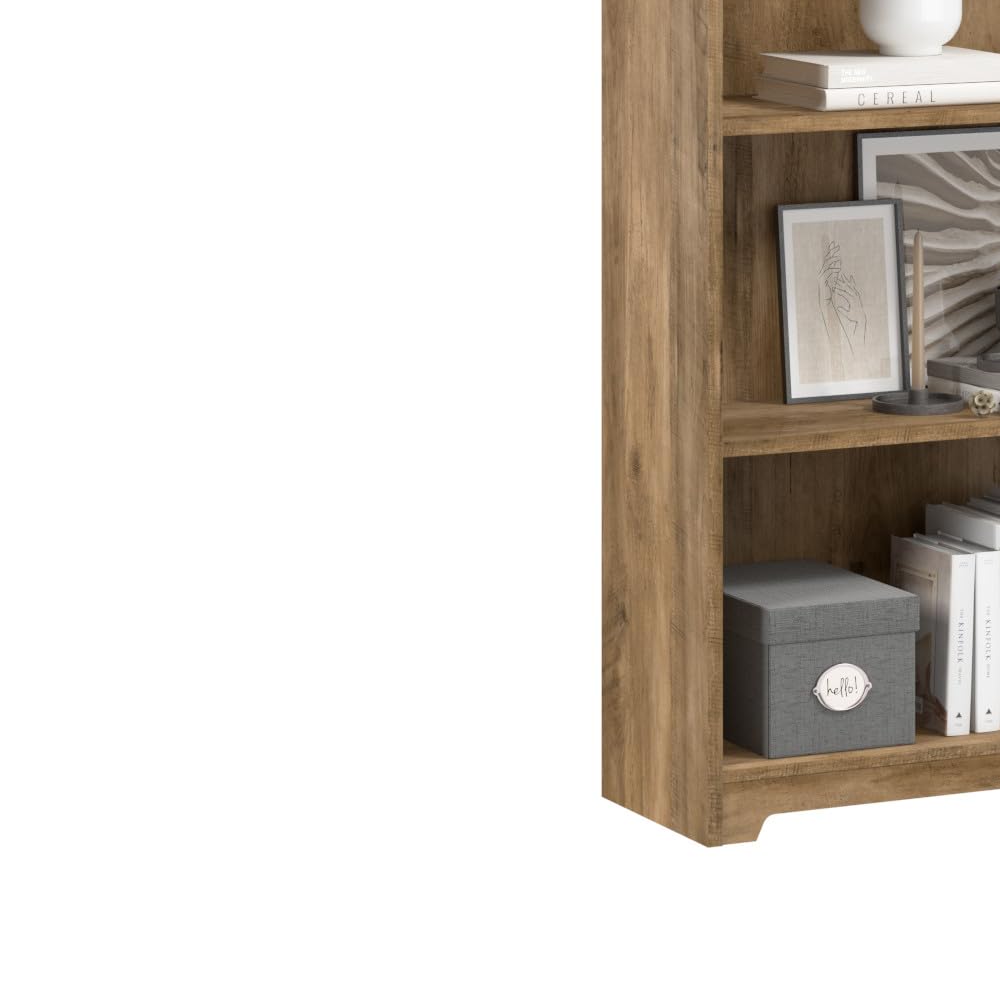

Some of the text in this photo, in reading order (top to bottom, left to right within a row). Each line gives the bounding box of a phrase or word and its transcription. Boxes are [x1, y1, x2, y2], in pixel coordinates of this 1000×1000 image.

[857, 89, 937, 106] CEREAL
[957, 621, 965, 663] KINFOLK
[826, 676, 858, 697] hello!
